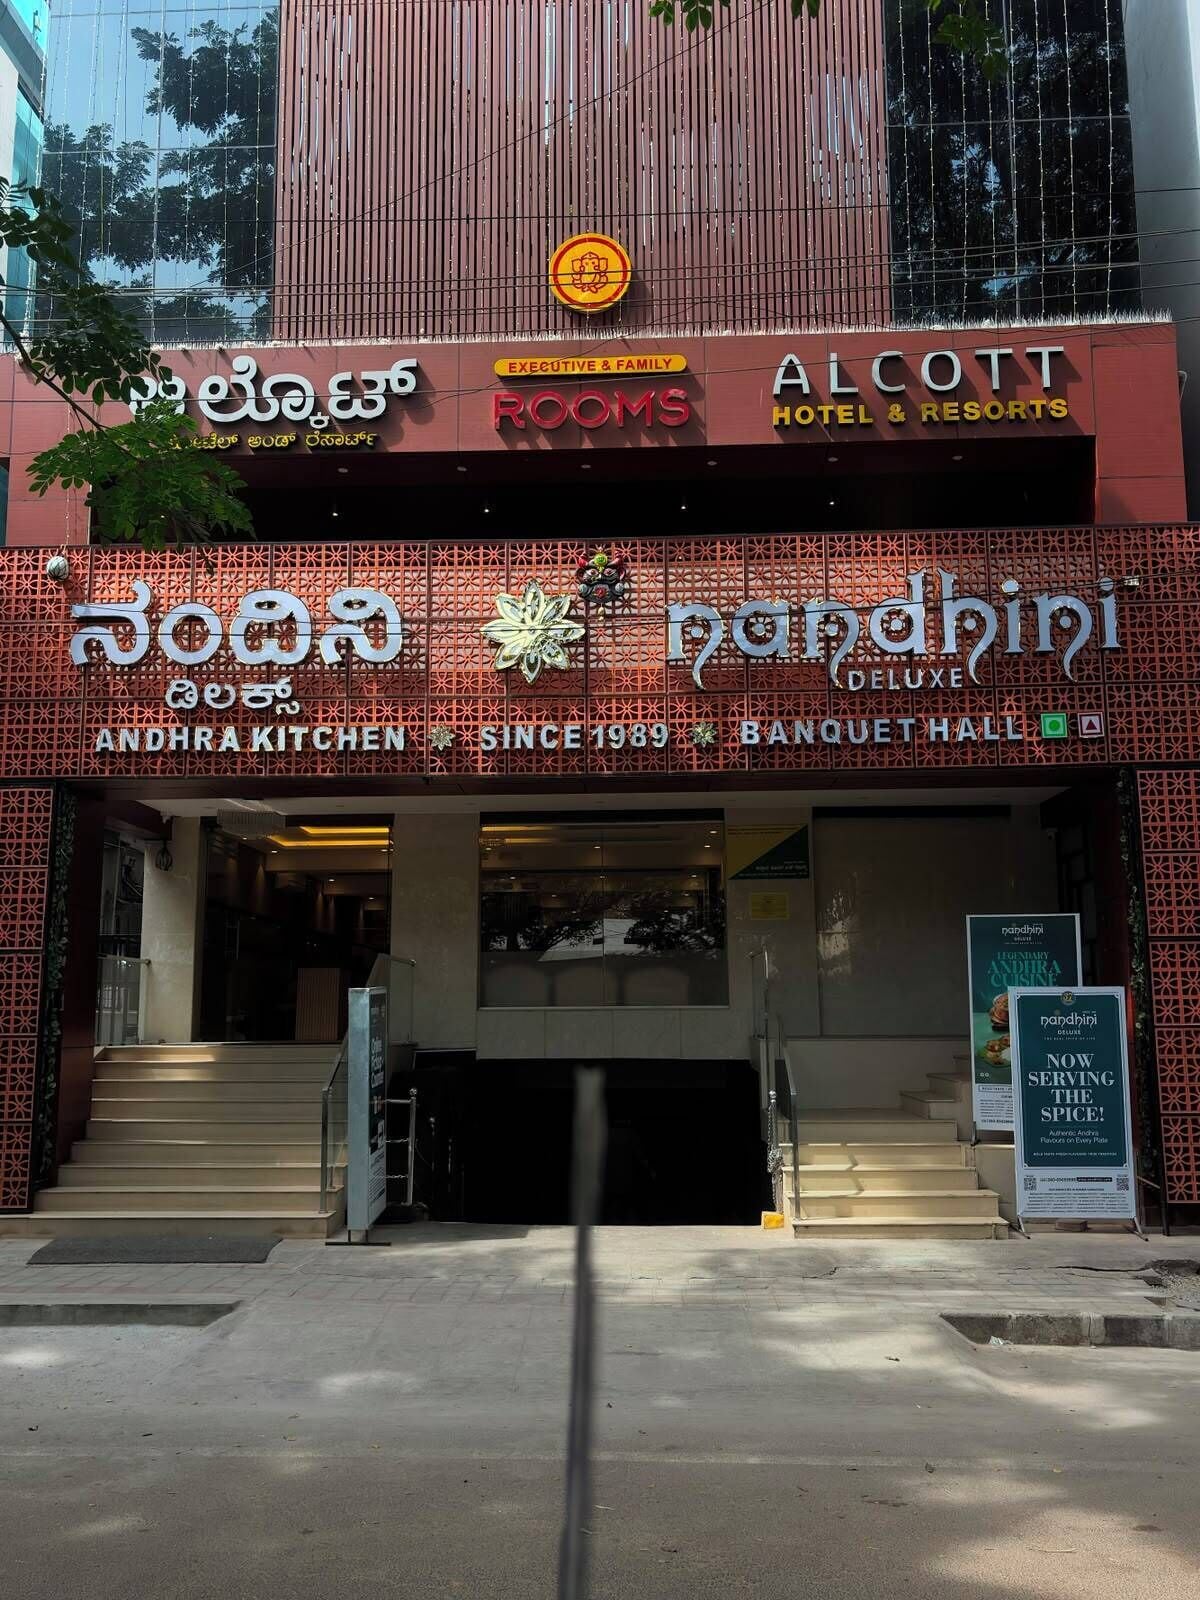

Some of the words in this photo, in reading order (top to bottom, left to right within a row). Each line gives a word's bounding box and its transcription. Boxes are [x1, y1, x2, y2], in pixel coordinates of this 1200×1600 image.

[508, 360, 596, 373] EXECUTIVE
[601, 360, 611, 371] &
[616, 358, 672, 371] FAMILY
[773, 346, 1064, 395] ALCOTT
[493, 388, 690, 430] ROOMS
[773, 404, 873, 425] HOTEL
[888, 403, 905, 423] &
[921, 398, 1068, 423] RESORTS
[247, 431, 297, 448] ಅಂಡ್
[69, 579, 403, 666] ನಂದಿನಿ
[665, 567, 1123, 690] nandhini
[848, 668, 963, 691] DELUXE
[165, 676, 300, 716] ಡಿಲಕ್ಸ್
[95, 727, 241, 752] ANDHRA
[251, 725, 406, 751] KITCHEN
[480, 724, 583, 751] SINCE
[591, 722, 669, 749] 1989
[740, 718, 917, 746] BANQUET
[929, 715, 1024, 742] HALL
[1001, 924, 1044, 936] nandhini
[997, 951, 1049, 960] LEGENDARY
[987, 960, 1062, 974] ANDHRA
[990, 973, 1058, 987] CUISINE
[1040, 1012, 1098, 1029] nandhini
[1047, 1053, 1095, 1069] NOW
[1028, 1071, 1115, 1087] SERVING
[1051, 1089, 1093, 1104] THE
[1041, 1107, 1105, 1123] SPICE!
[1075, 1136, 1093, 1145] Every
[1077, 1129, 1099, 1137] Andhra
